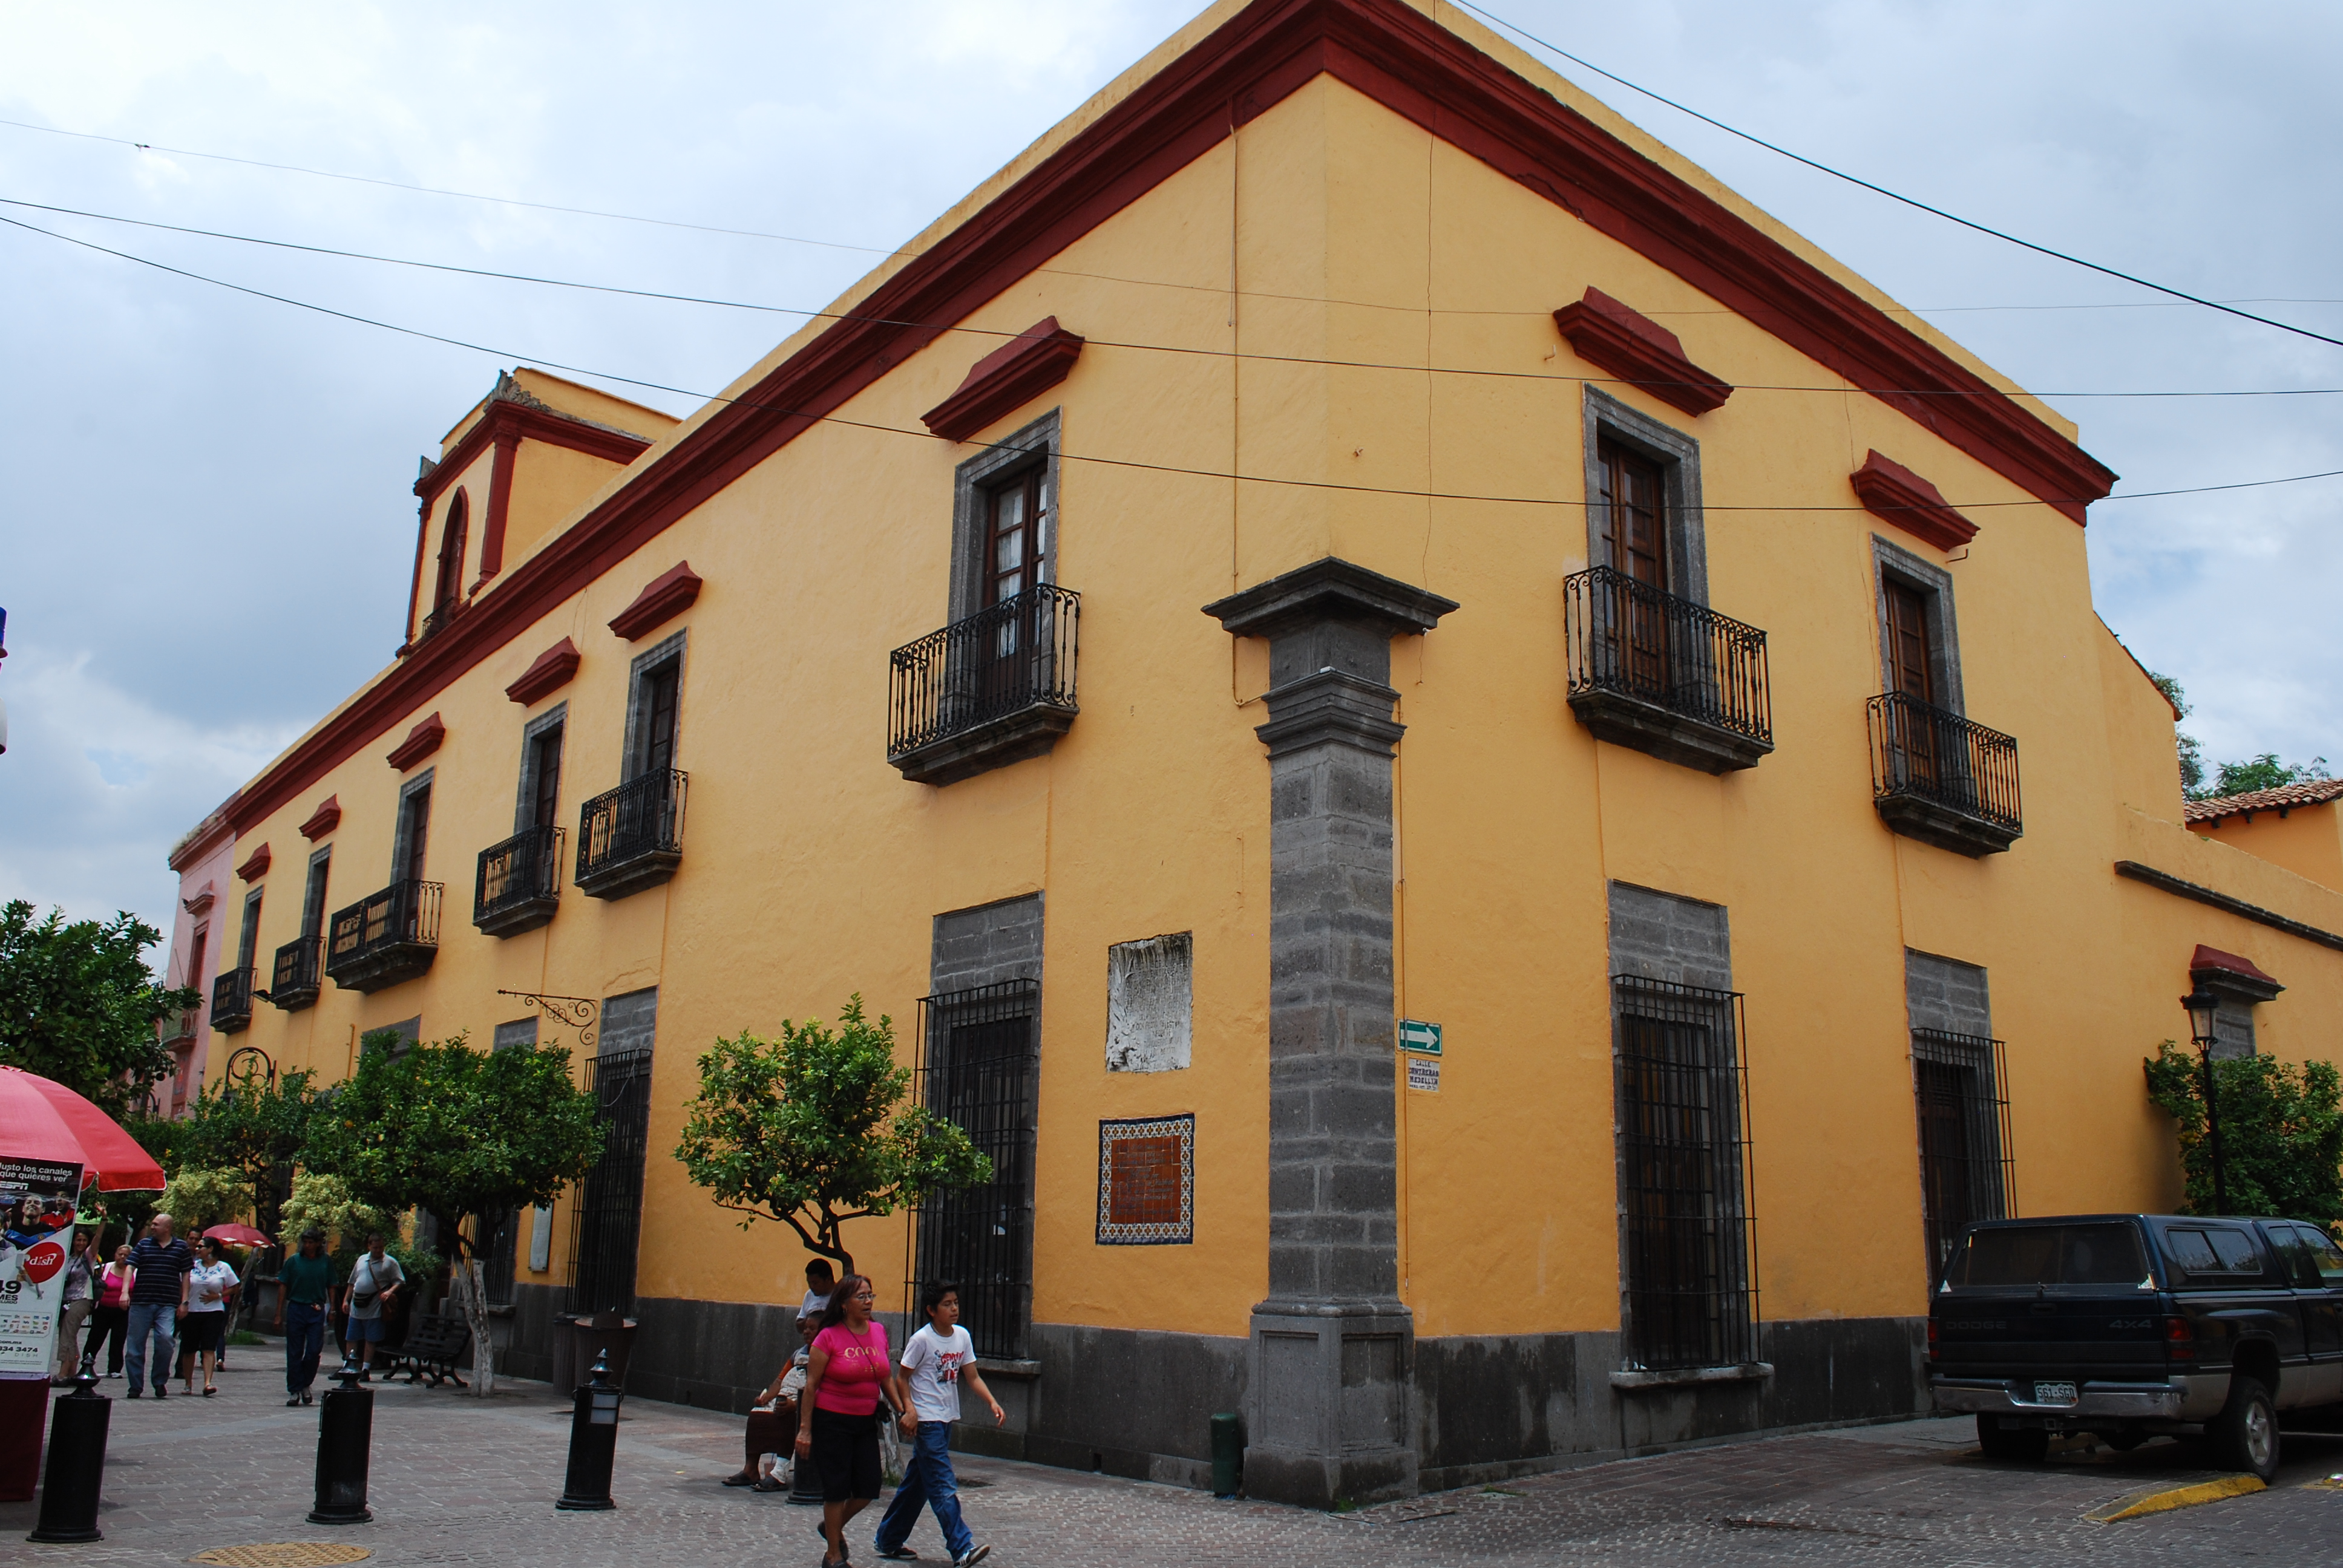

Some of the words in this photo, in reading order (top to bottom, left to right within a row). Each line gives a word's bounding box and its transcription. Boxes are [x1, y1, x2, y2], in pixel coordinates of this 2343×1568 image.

[23, 1165, 36, 1173] los
[39, 1168, 73, 1176] canales
[19, 1172, 51, 1181] quieres
[0, 1180, 29, 1191] ESPN
[30, 1253, 57, 1266] dish
[1945, 1321, 2007, 1330] DODGE
